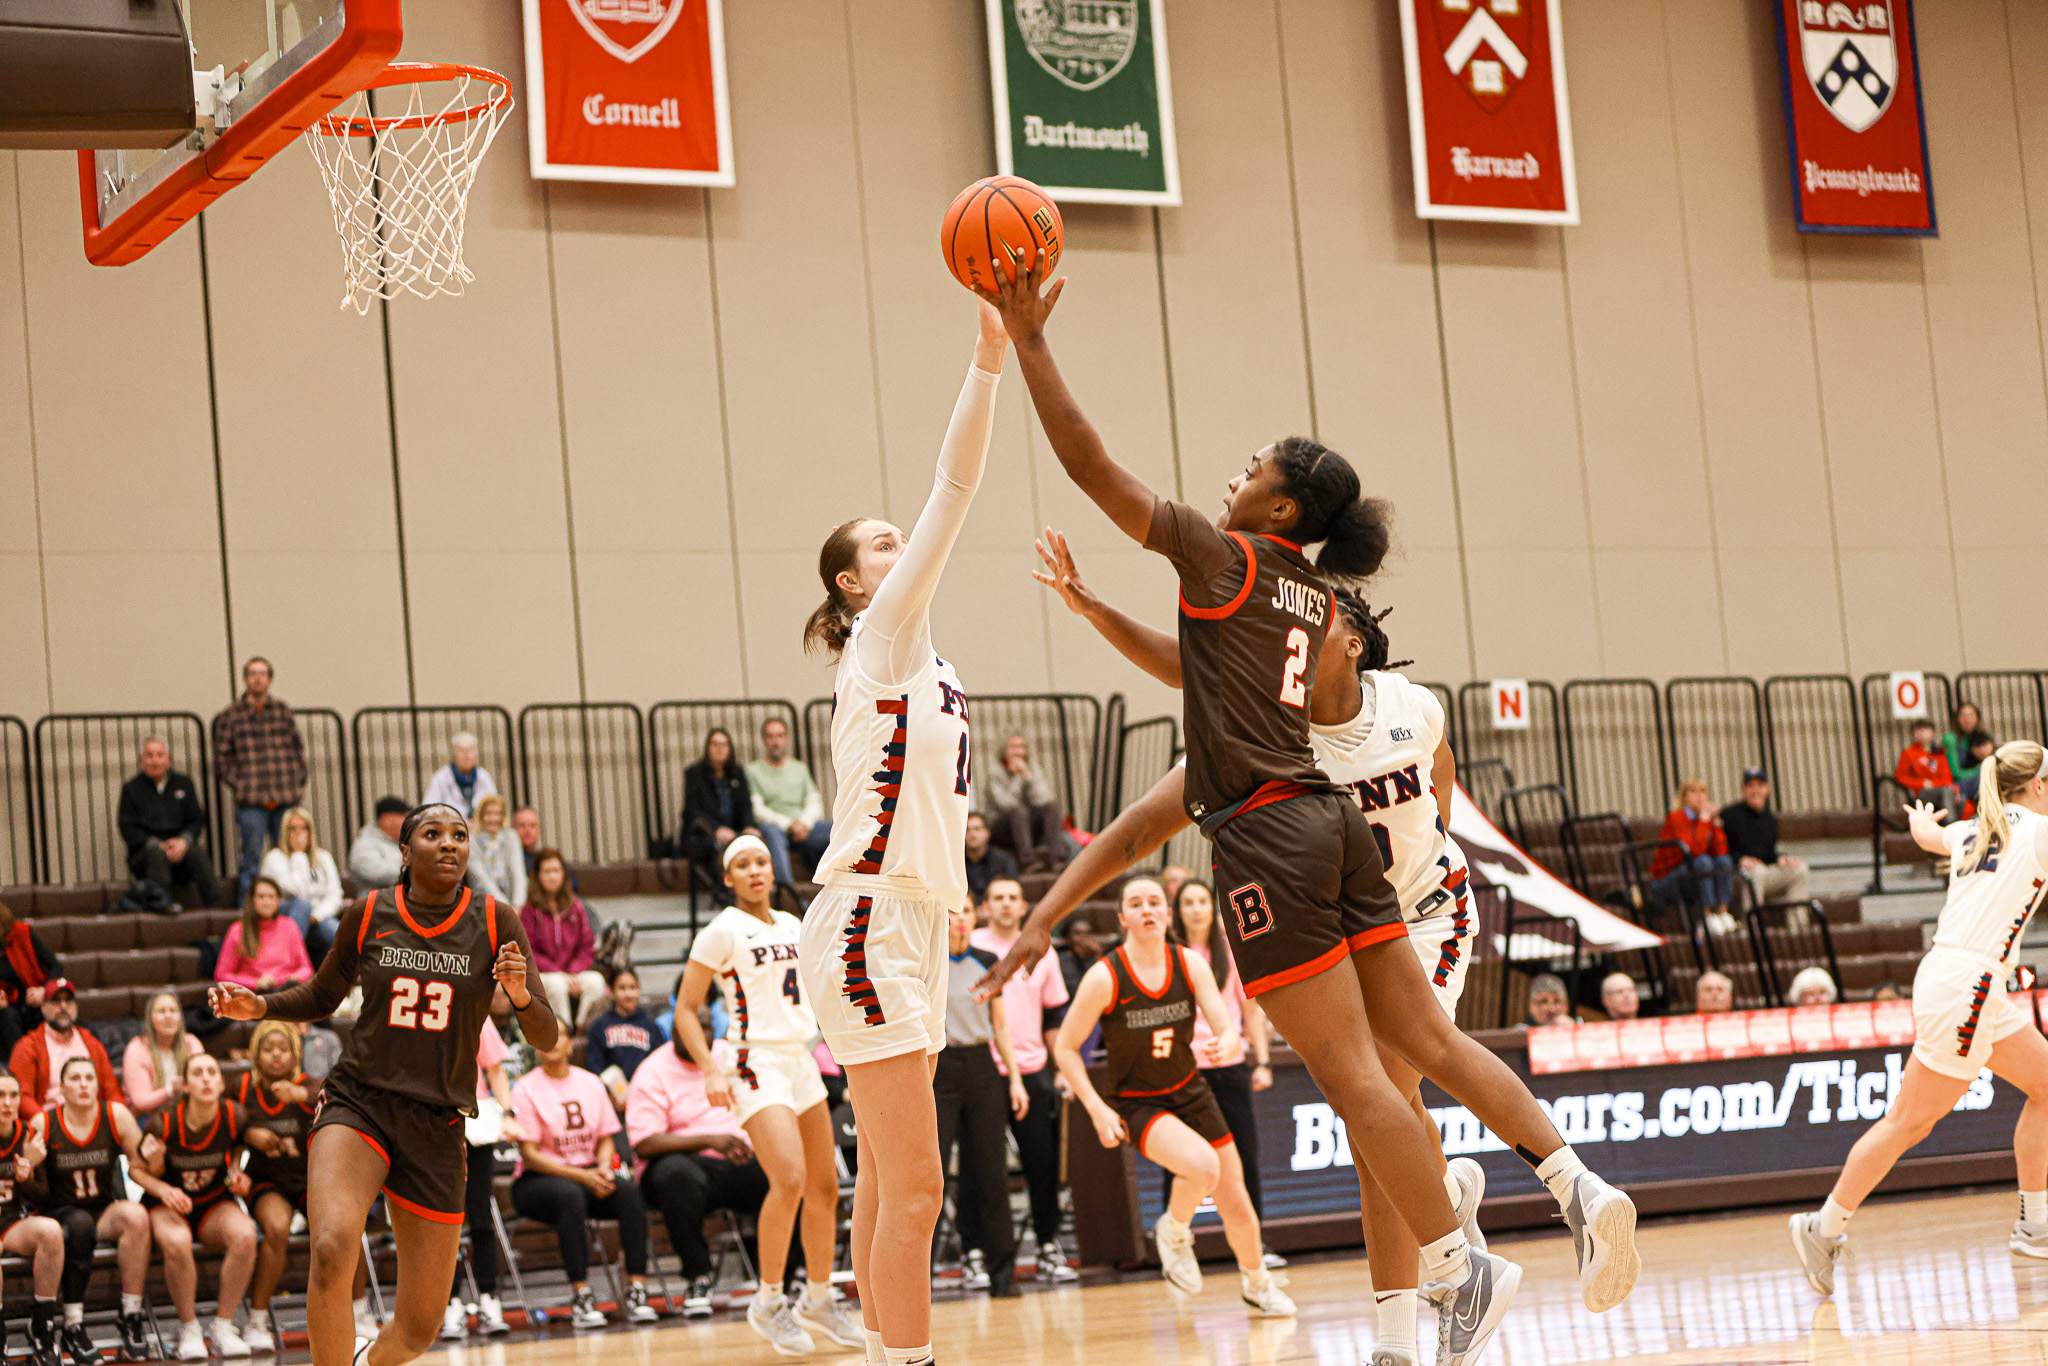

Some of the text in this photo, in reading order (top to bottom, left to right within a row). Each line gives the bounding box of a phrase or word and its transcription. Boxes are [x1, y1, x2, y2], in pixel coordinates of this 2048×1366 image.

[582, 93, 681, 128] Cornell
[1023, 115, 1149, 158] Dartmouth
[1451, 146, 1540, 182] Harvard
[1803, 159, 1921, 197] Pennsylvania
[1271, 576, 1326, 627] JONES
[1279, 625, 1310, 710] 2
[938, 681, 970, 728] PE
[1499, 688, 1522, 720] N
[1897, 680, 1920, 710] O
[954, 730, 971, 797] 1
[1345, 763, 1422, 814] NN
[1229, 882, 1275, 942] B
[379, 946, 469, 976] BROWN
[750, 944, 800, 967] PEN
[388, 975, 454, 1032] 23
[783, 967, 801, 1006] 4
[1151, 1027, 1175, 1060] 5
[561, 1101, 585, 1131] B
[72, 1168, 99, 1199] 11
